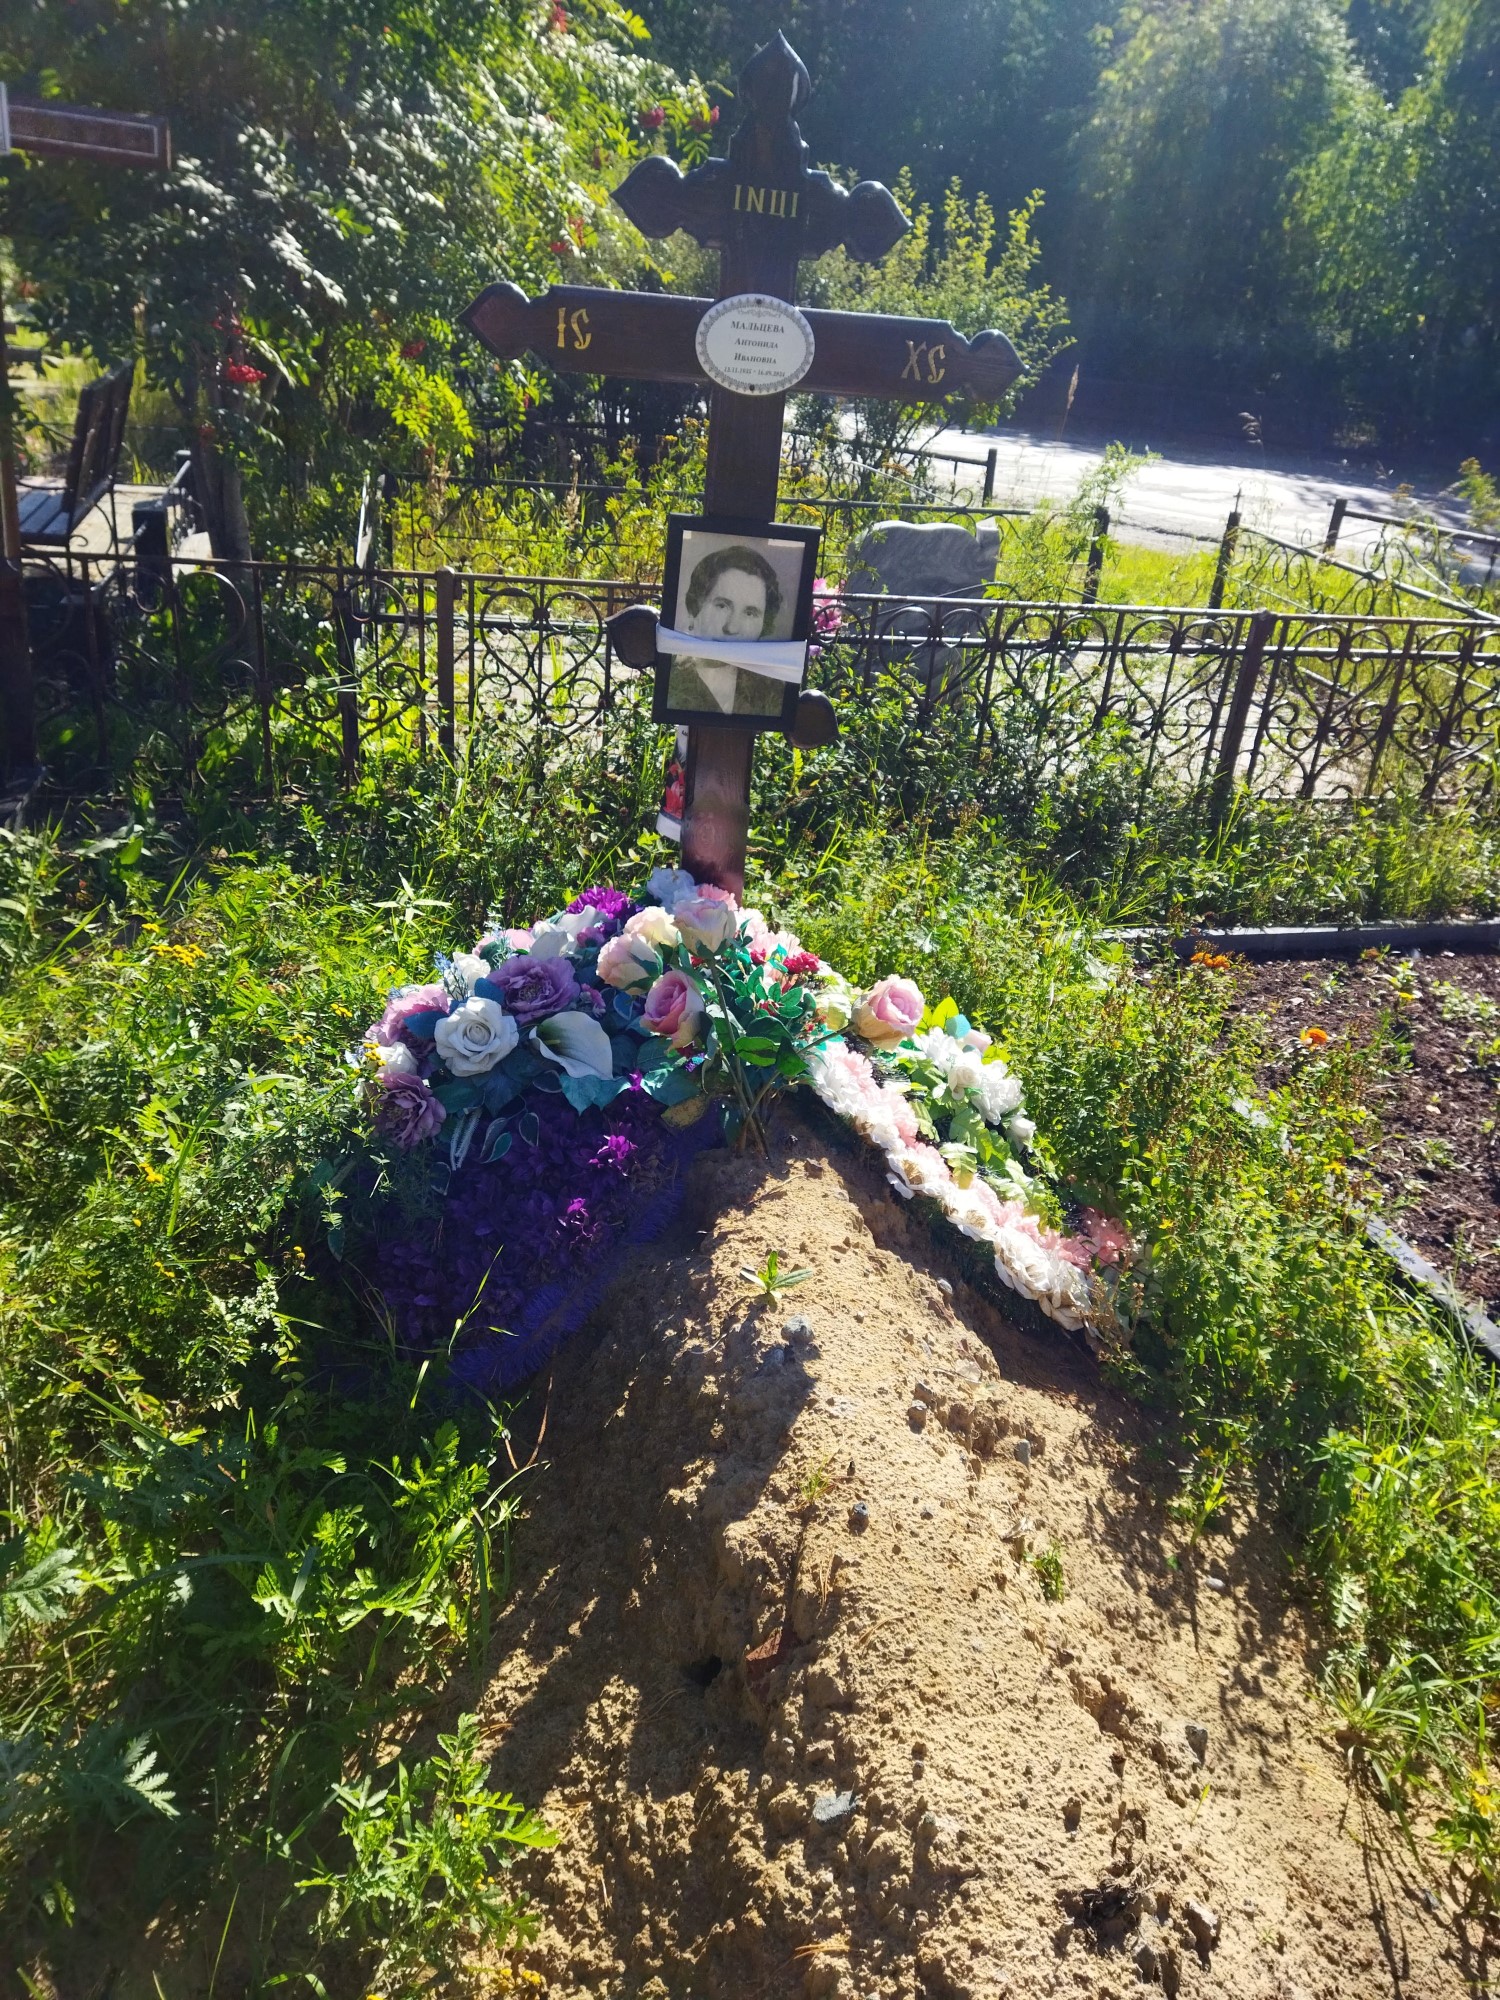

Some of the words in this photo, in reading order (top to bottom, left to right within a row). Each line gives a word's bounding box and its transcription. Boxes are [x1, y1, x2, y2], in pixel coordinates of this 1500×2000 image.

[731, 320, 784, 334] МАЛЬЦЕВА
[735, 338, 778, 349] АНТОНИДА
[734, 353, 776, 364] ИВАНОВНА
